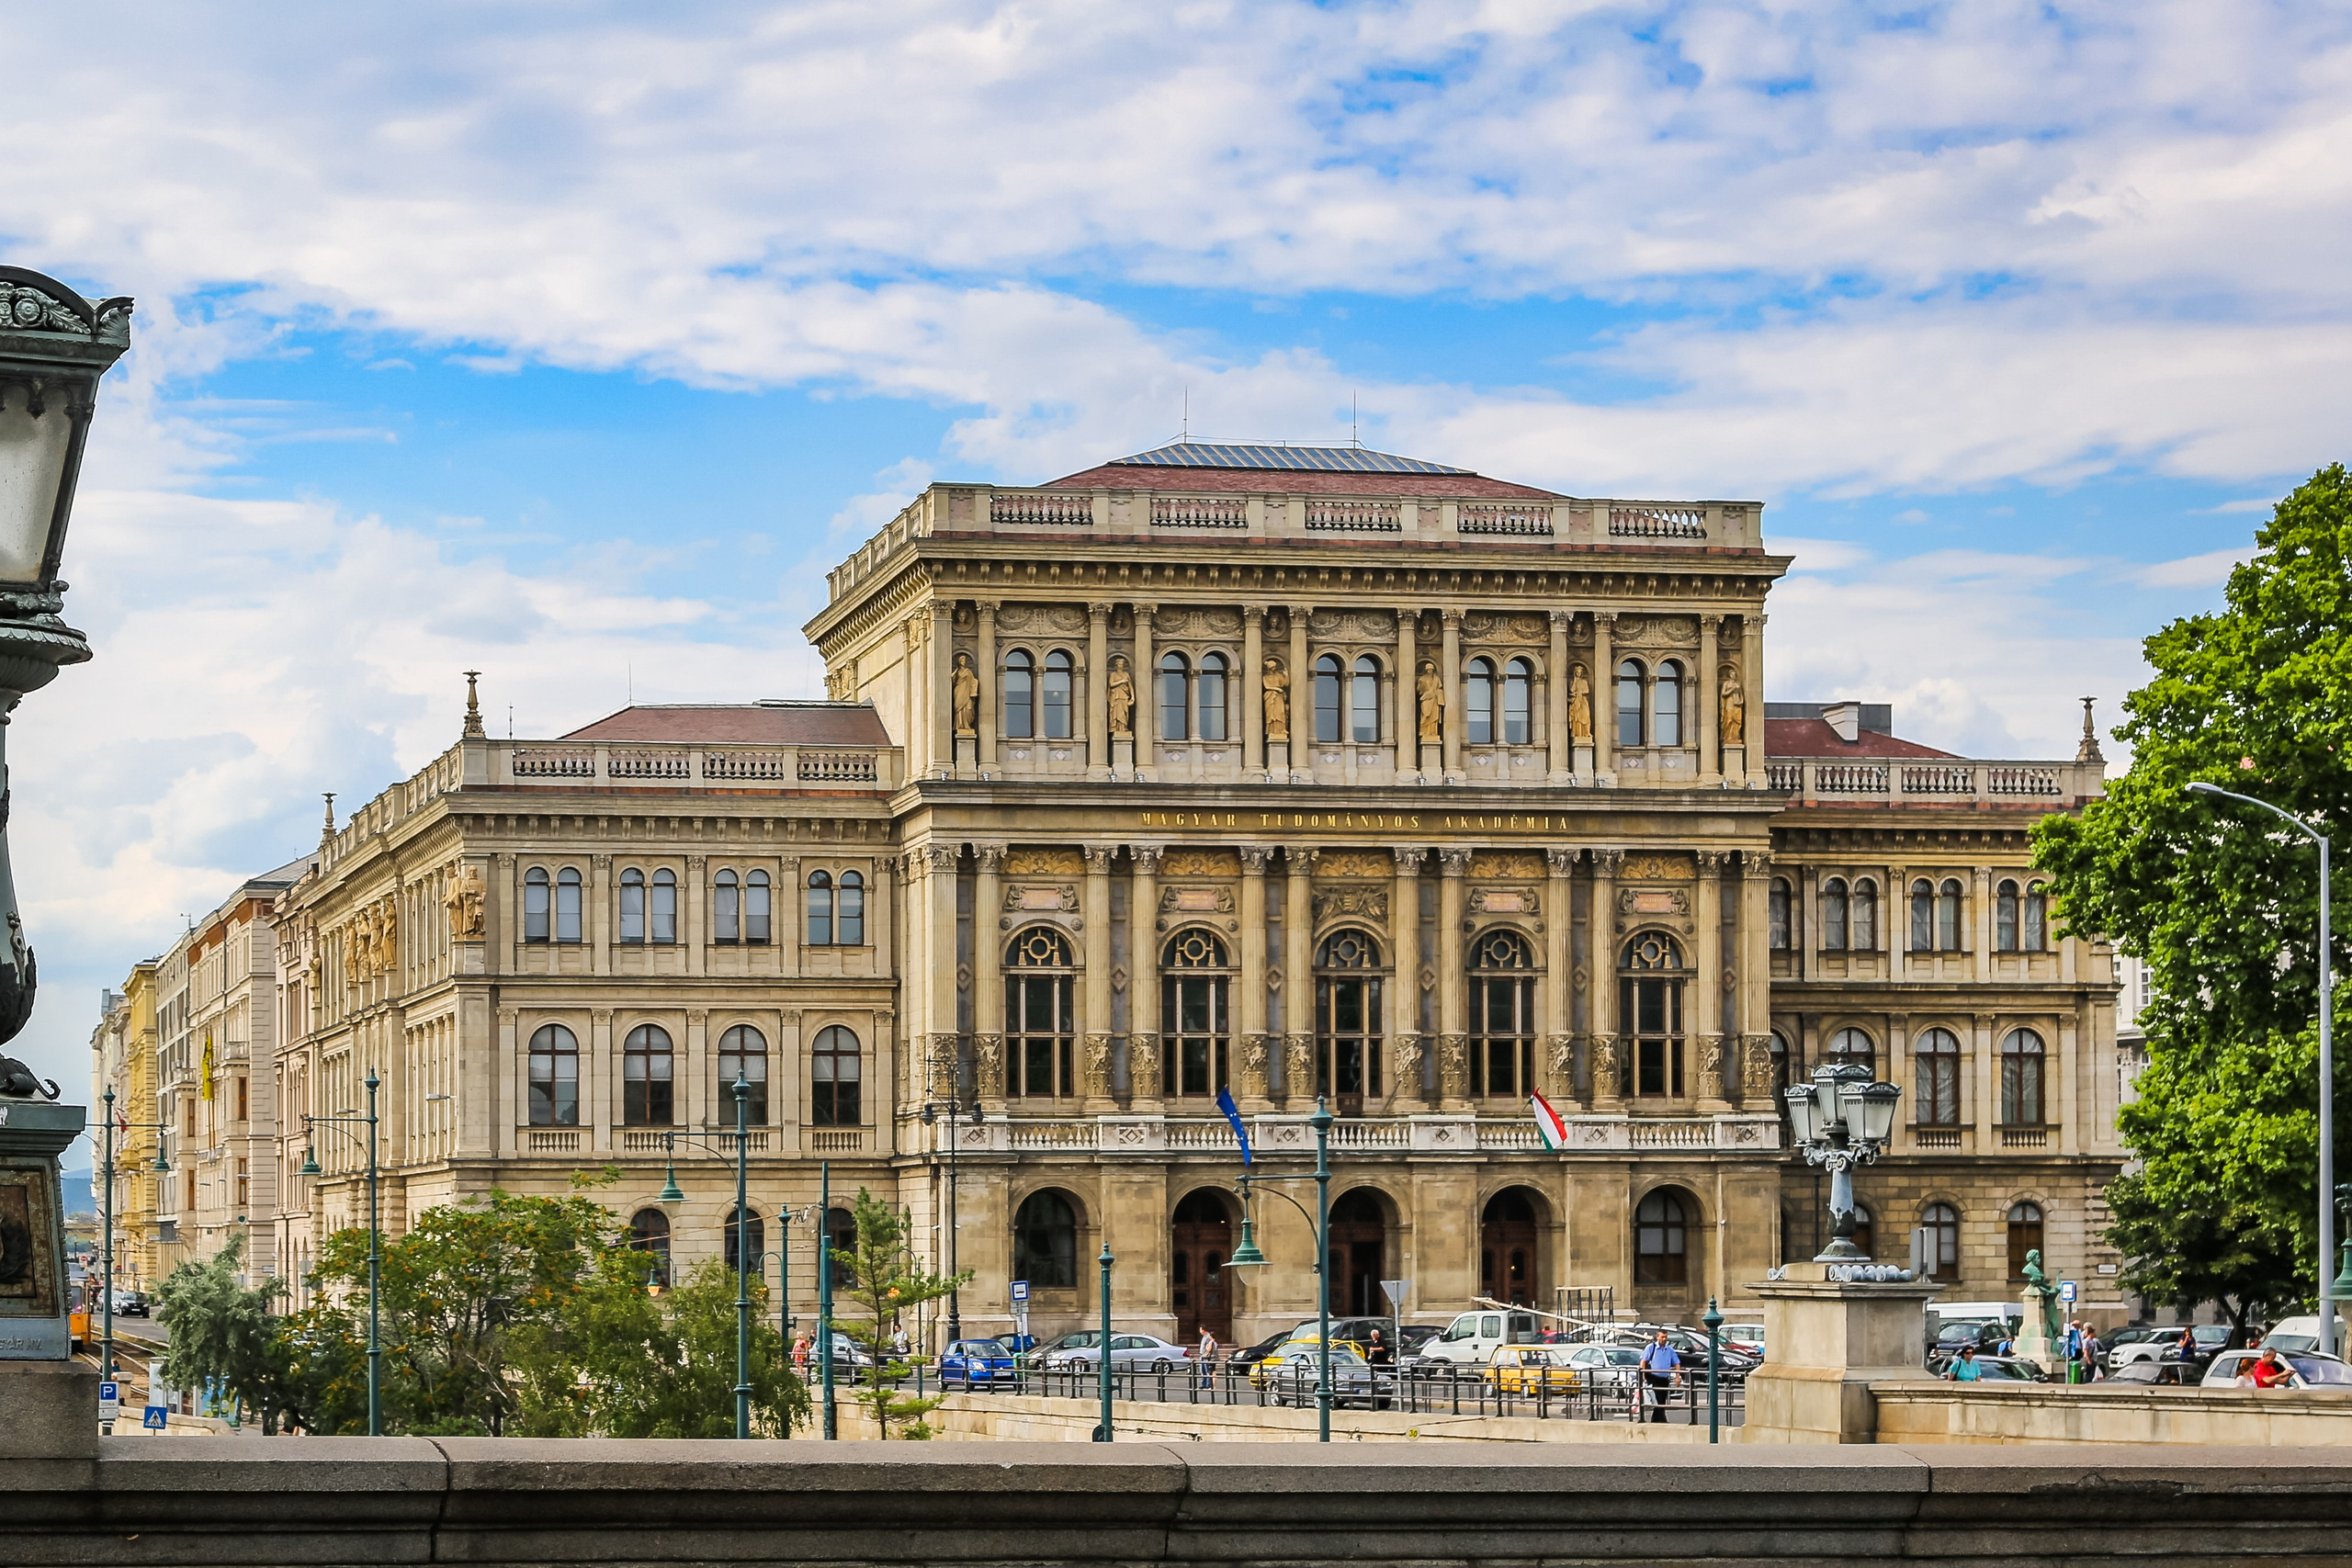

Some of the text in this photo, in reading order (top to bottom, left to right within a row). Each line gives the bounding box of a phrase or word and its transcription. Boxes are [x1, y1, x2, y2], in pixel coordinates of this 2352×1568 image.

[1142, 813, 1567, 829] MAGYAR TUDOMÁNYOS AKADÉMIA
[103, 1386, 114, 1398] P
[1408, 1429, 1419, 1438] 30
